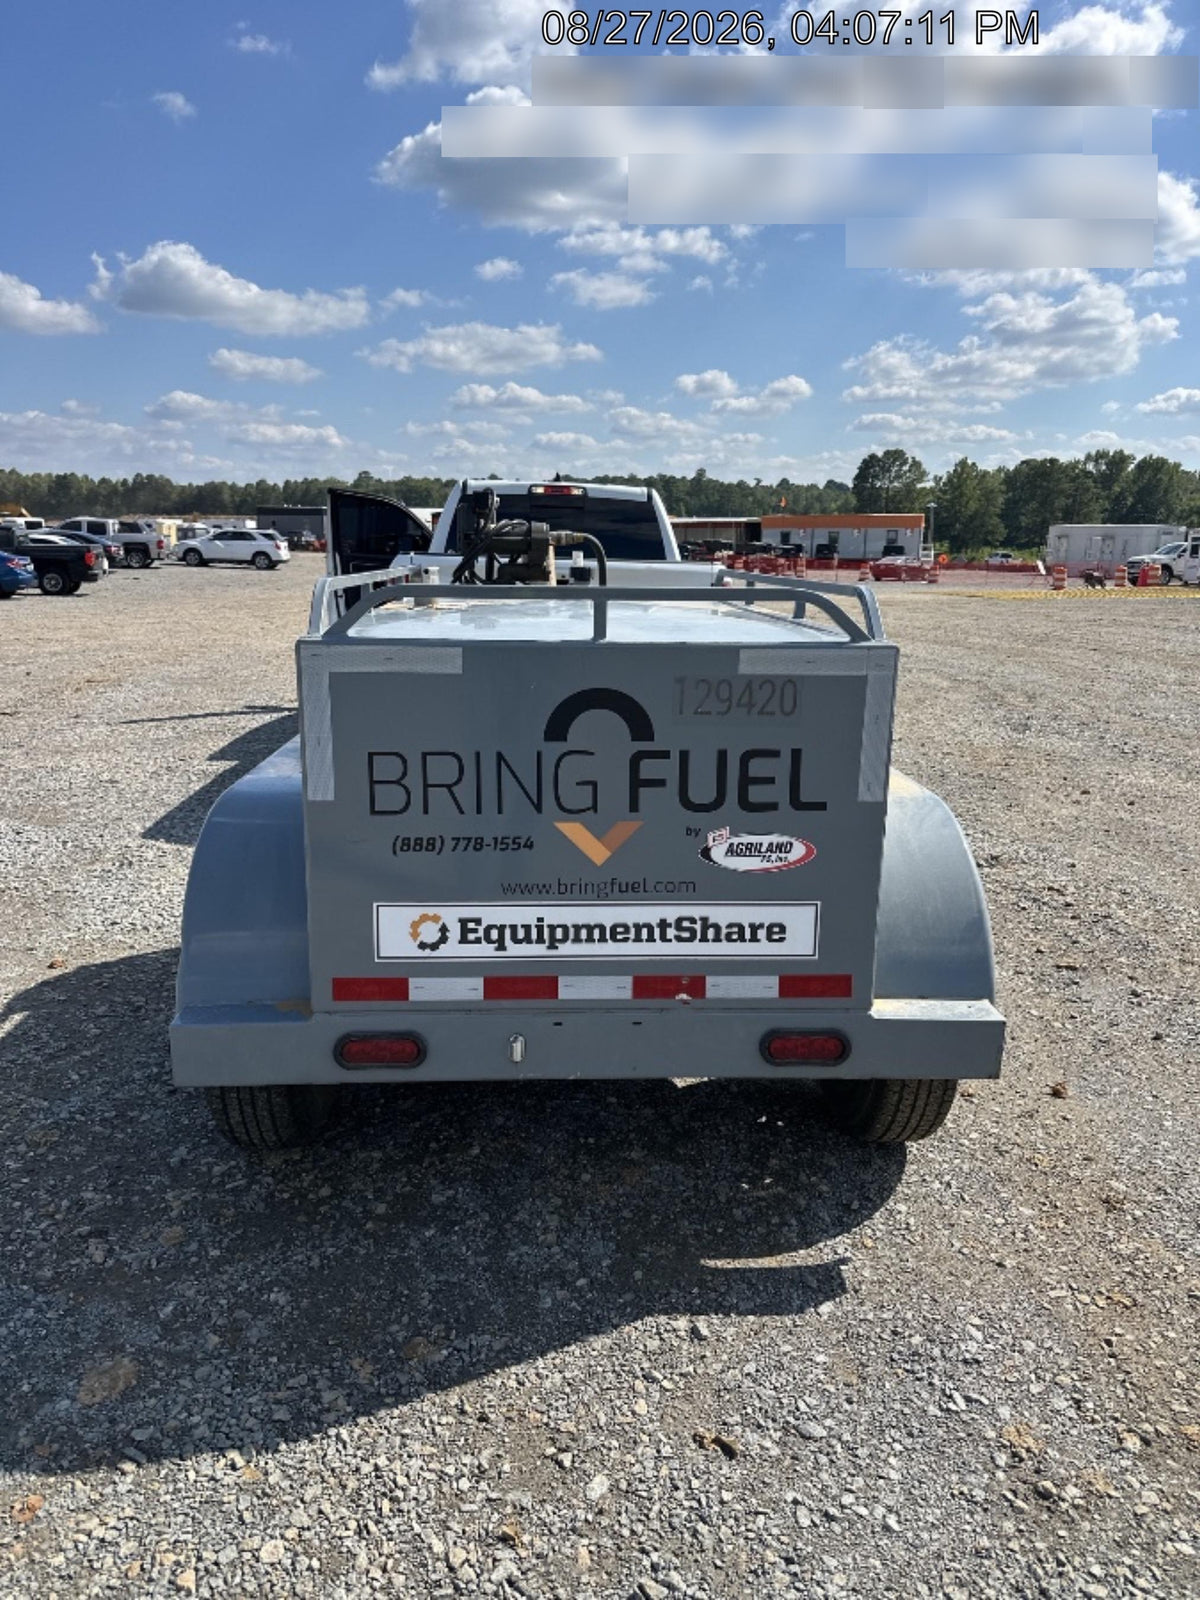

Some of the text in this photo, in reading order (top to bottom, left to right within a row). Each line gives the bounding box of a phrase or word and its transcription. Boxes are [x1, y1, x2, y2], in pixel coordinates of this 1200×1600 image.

[367, 749, 828, 816] BRING FUEL
[685, 826, 701, 838] by
[392, 835, 535, 857] (888) 778-1554
[725, 841, 793, 856] AGRILAND
[500, 878, 697, 898] www.bringfuel.com
[457, 915, 788, 951] EquipmentShare
